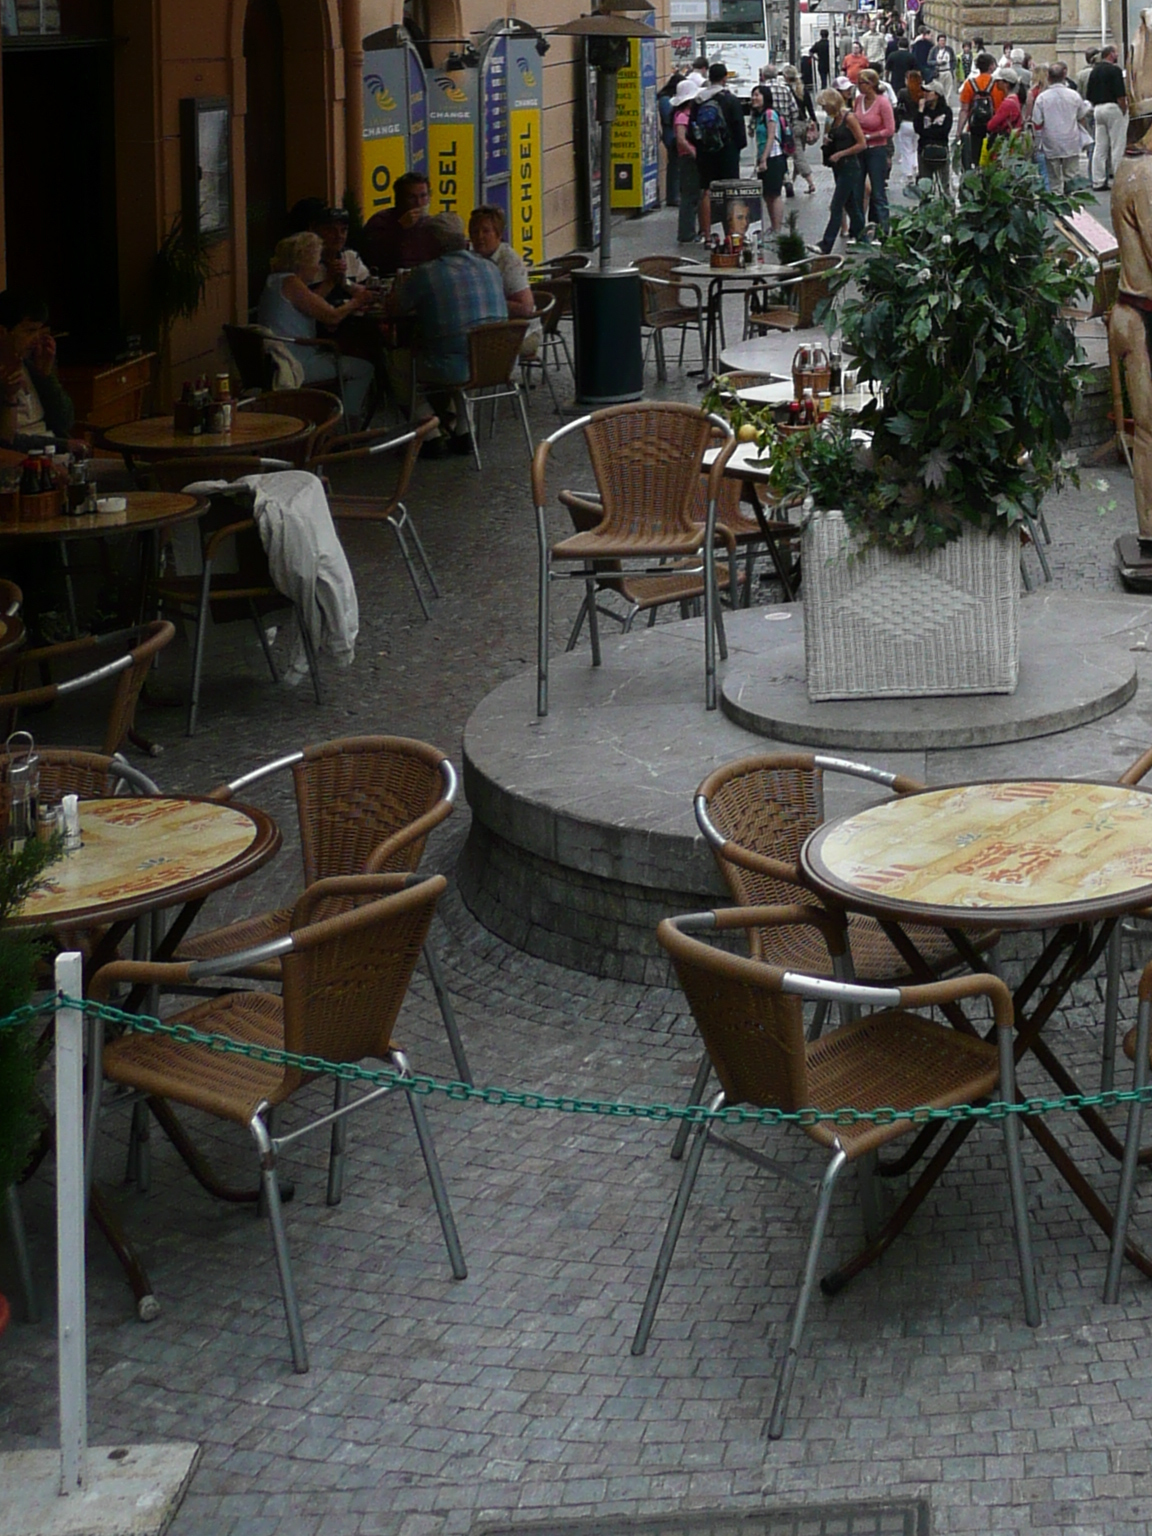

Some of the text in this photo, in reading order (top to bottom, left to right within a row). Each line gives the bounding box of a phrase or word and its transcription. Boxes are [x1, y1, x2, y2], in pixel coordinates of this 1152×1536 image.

[514, 98, 538, 107] CHANGE
[429, 111, 471, 119] CHANGE
[362, 123, 400, 137] CHANGE
[520, 122, 534, 267] WECHSEL
